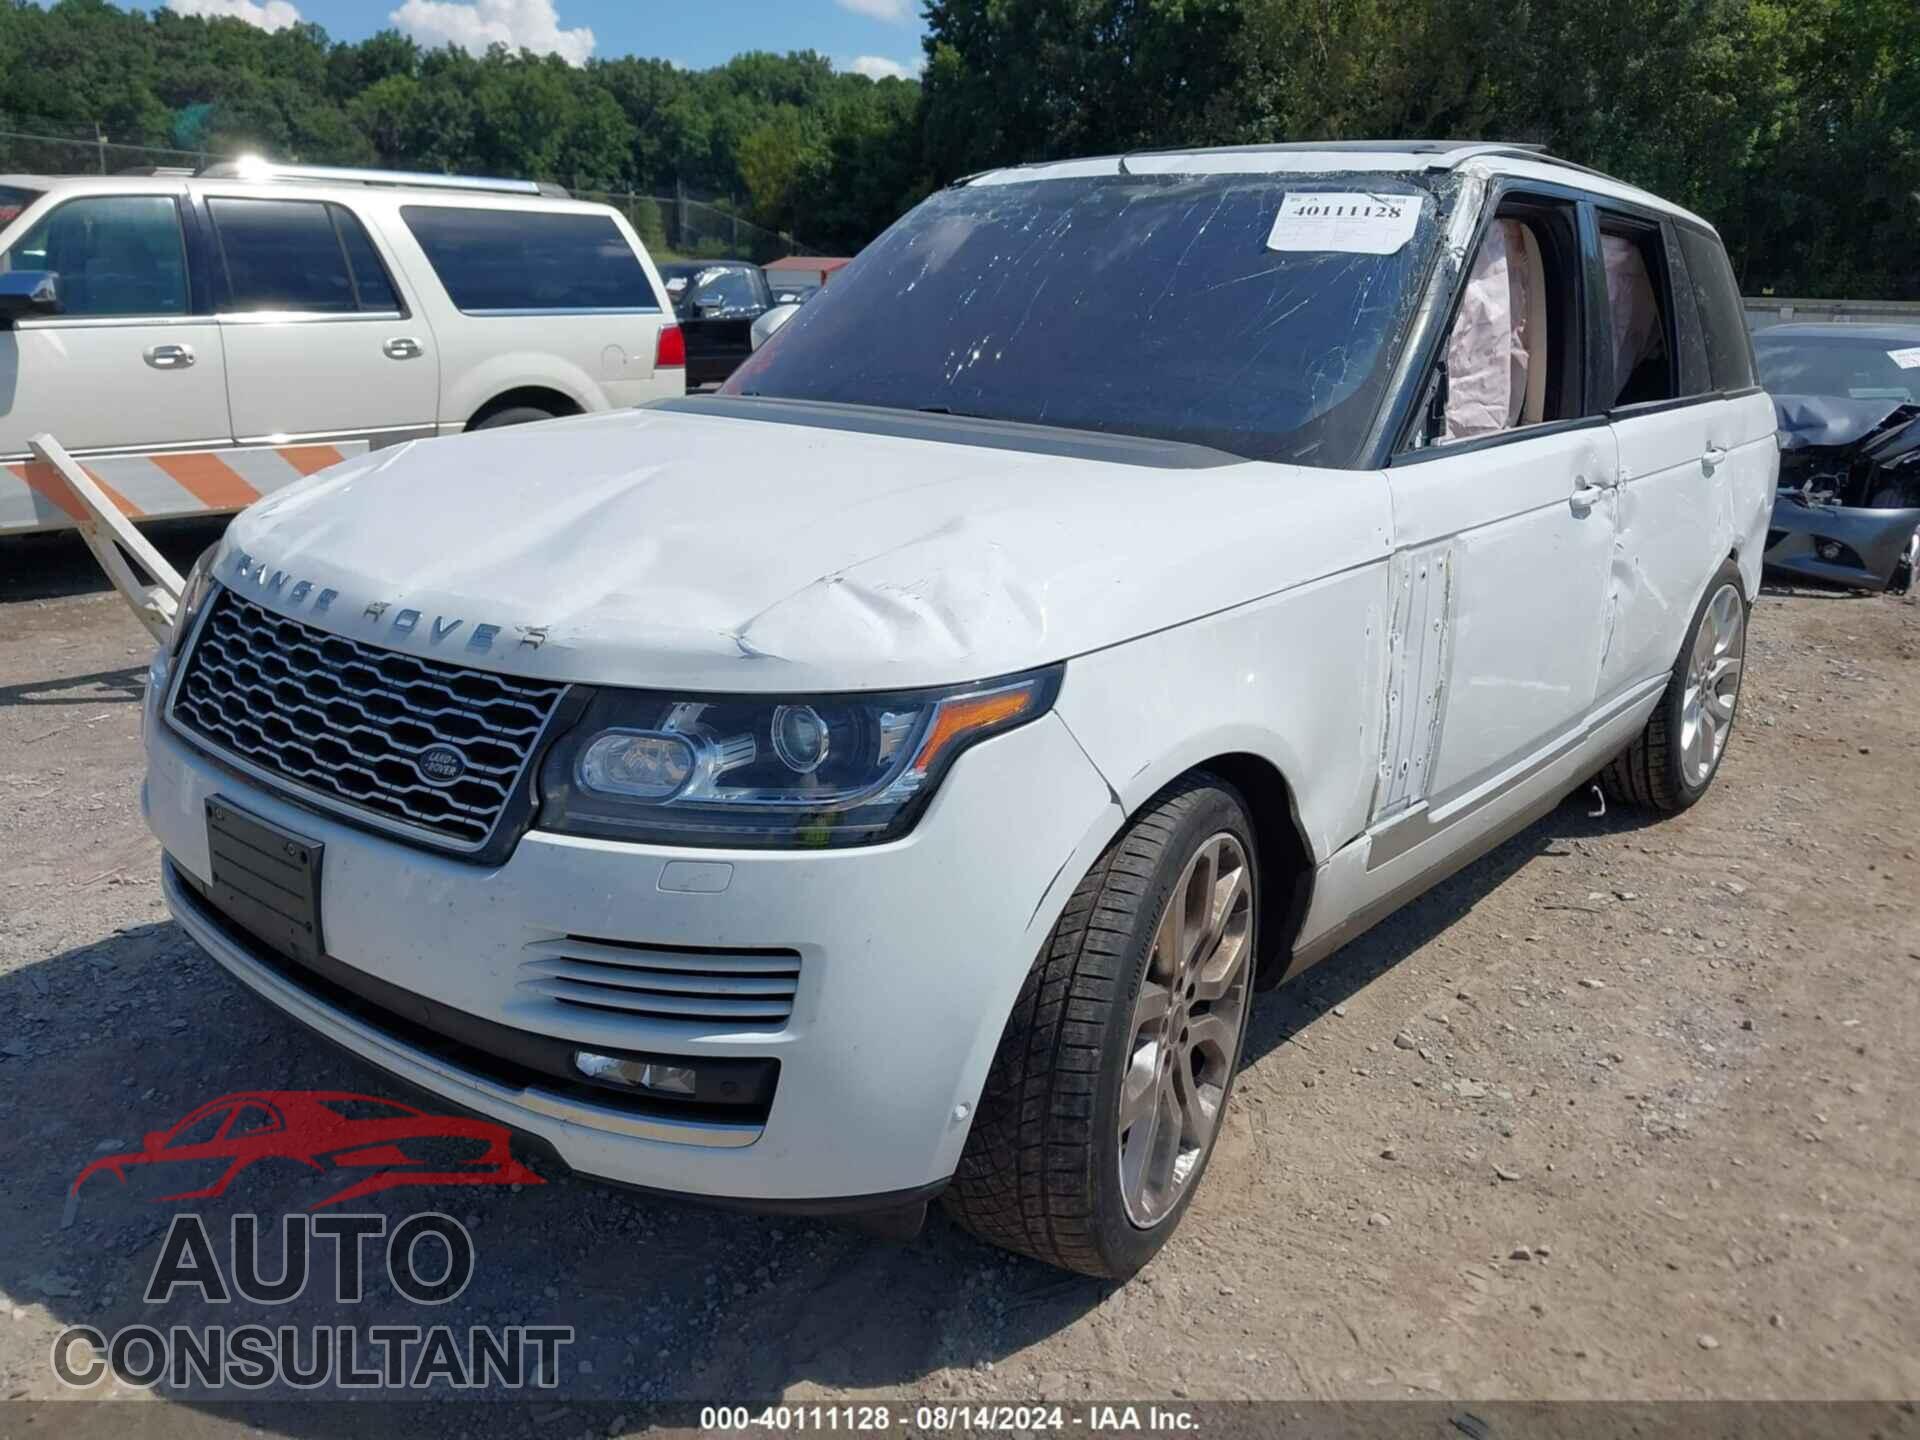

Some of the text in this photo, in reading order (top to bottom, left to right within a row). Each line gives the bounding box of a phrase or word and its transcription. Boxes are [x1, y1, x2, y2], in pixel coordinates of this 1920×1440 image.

[1293, 205, 1401, 217] 40111128
[236, 553, 552, 654] RANGE ROVER
